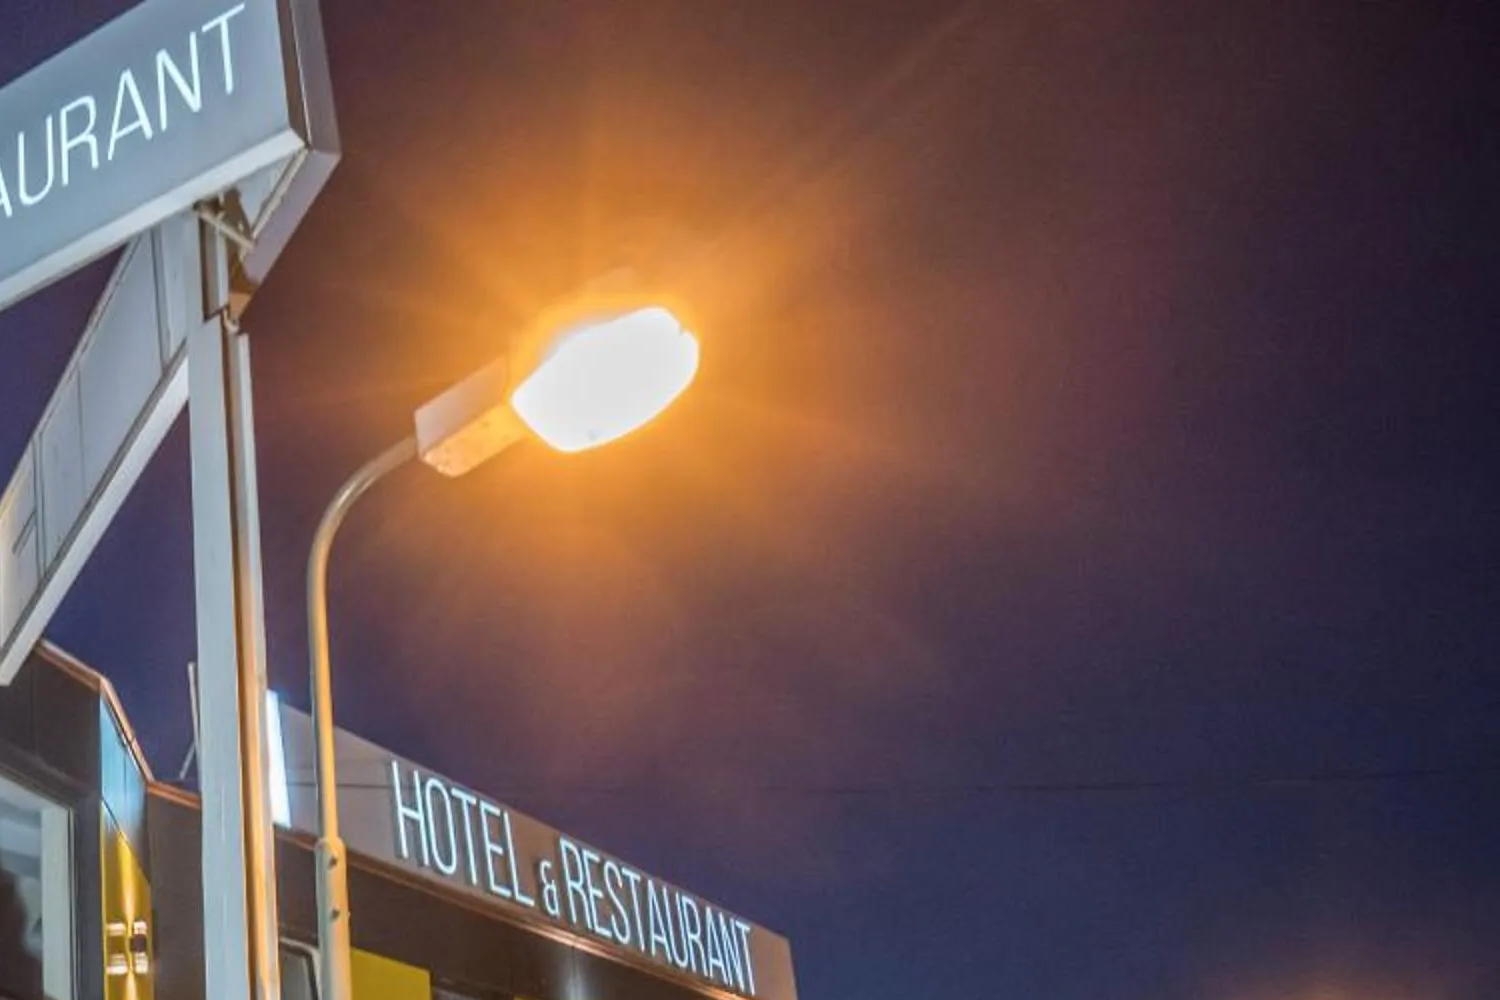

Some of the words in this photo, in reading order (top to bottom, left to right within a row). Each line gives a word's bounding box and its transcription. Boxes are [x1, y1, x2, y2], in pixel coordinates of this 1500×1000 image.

[391, 760, 535, 907] HOTEL
[539, 858, 562, 917] &
[559, 836, 756, 997] RESTAURANT
